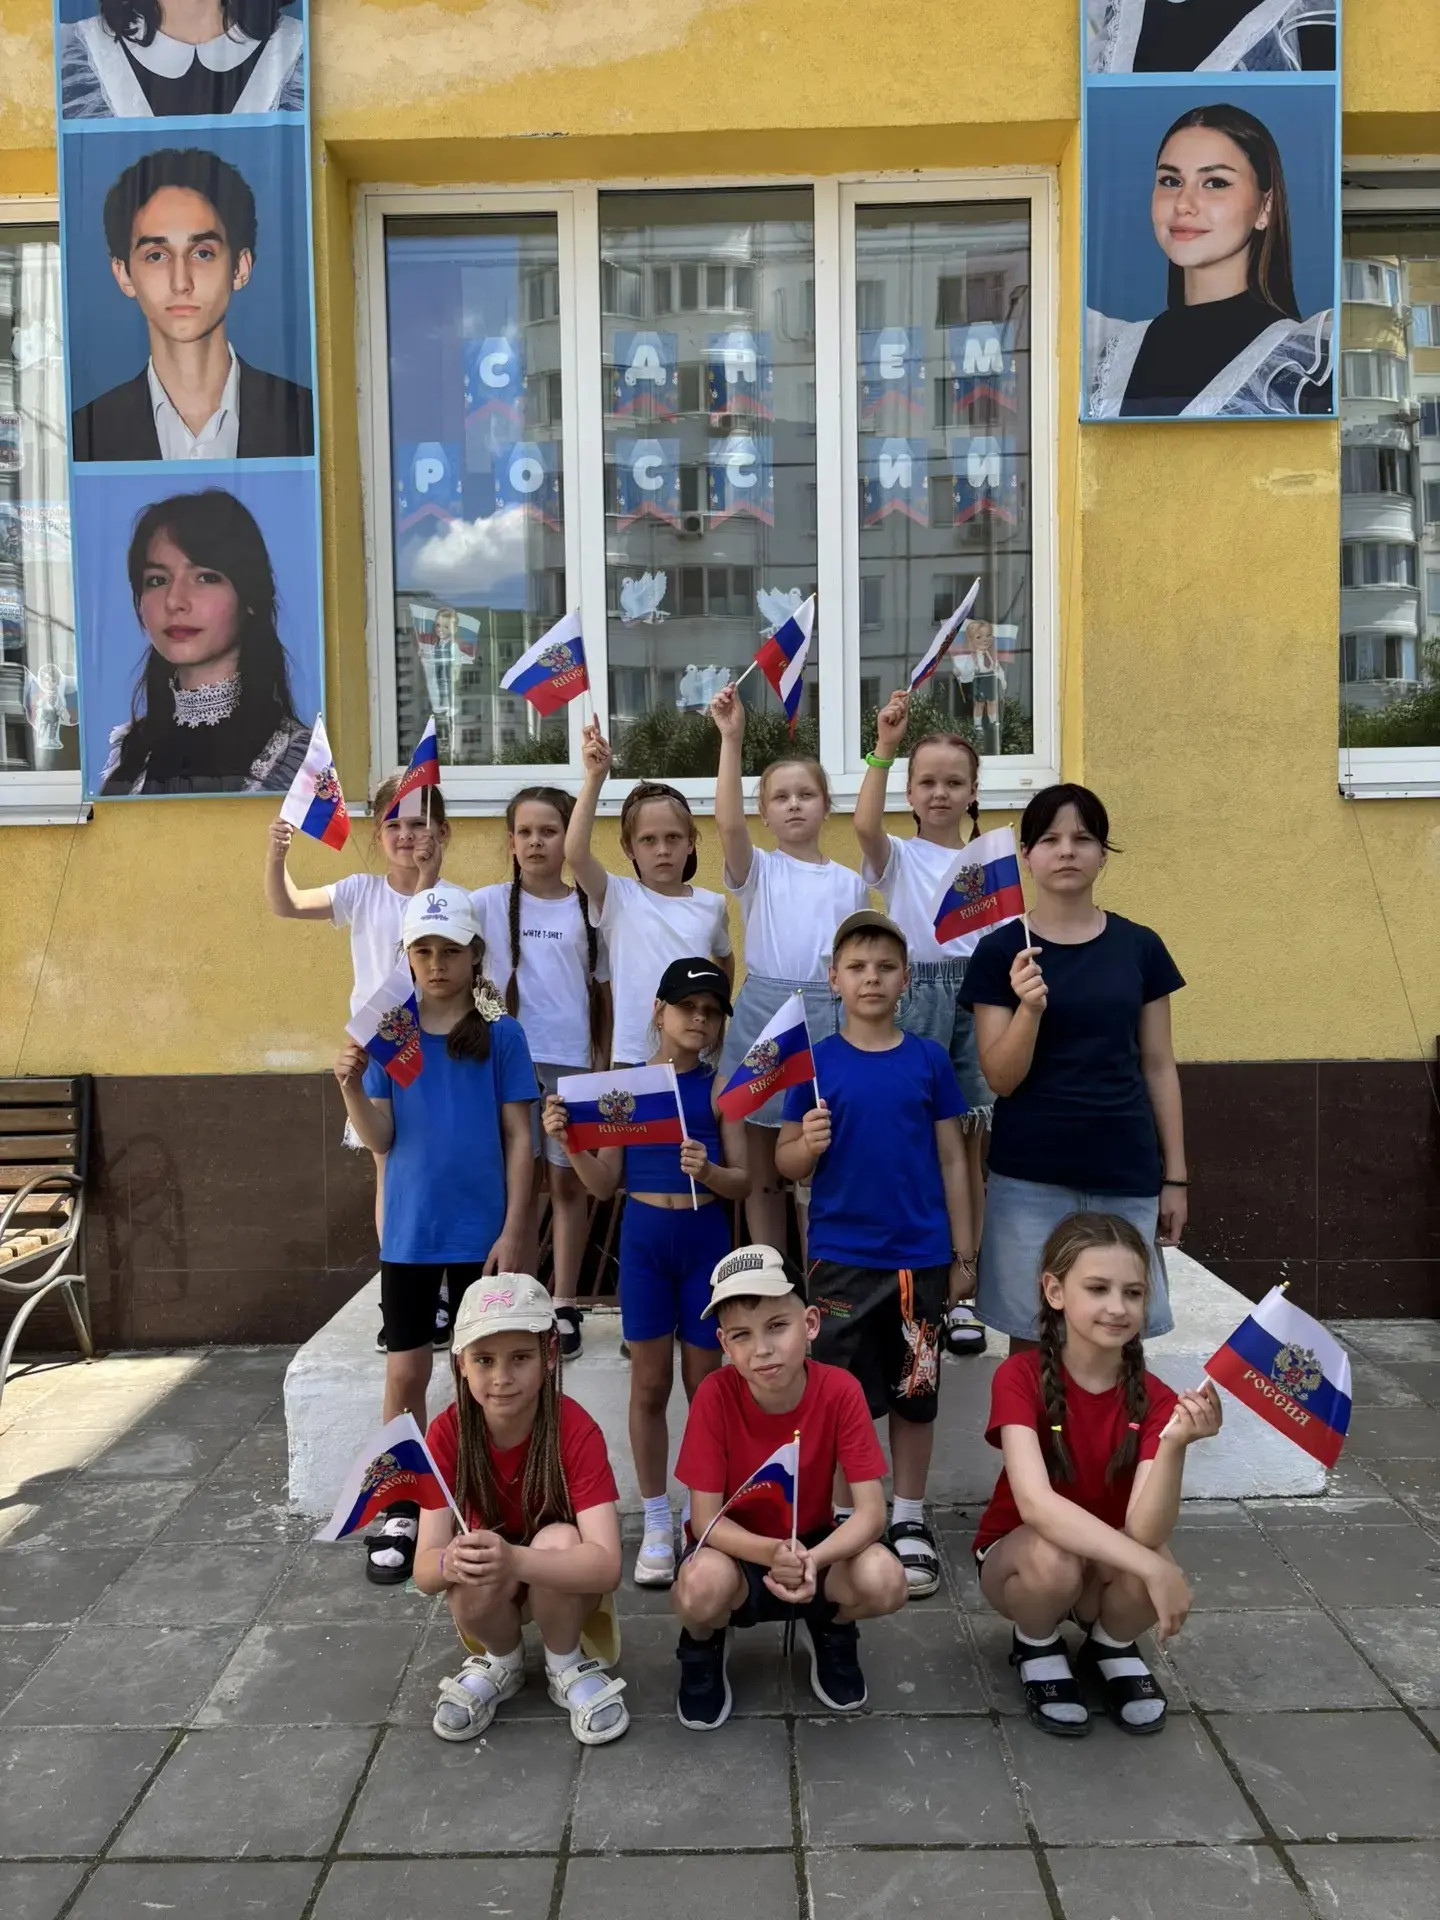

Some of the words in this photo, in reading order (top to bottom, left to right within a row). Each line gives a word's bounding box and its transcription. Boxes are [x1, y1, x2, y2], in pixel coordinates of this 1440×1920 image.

[478, 351, 511, 388] С
[415, 453, 1000, 493] РОССИИ
[718, 1259, 763, 1283] UNIQUE
[1243, 1370, 1312, 1428] РОССИЯ
